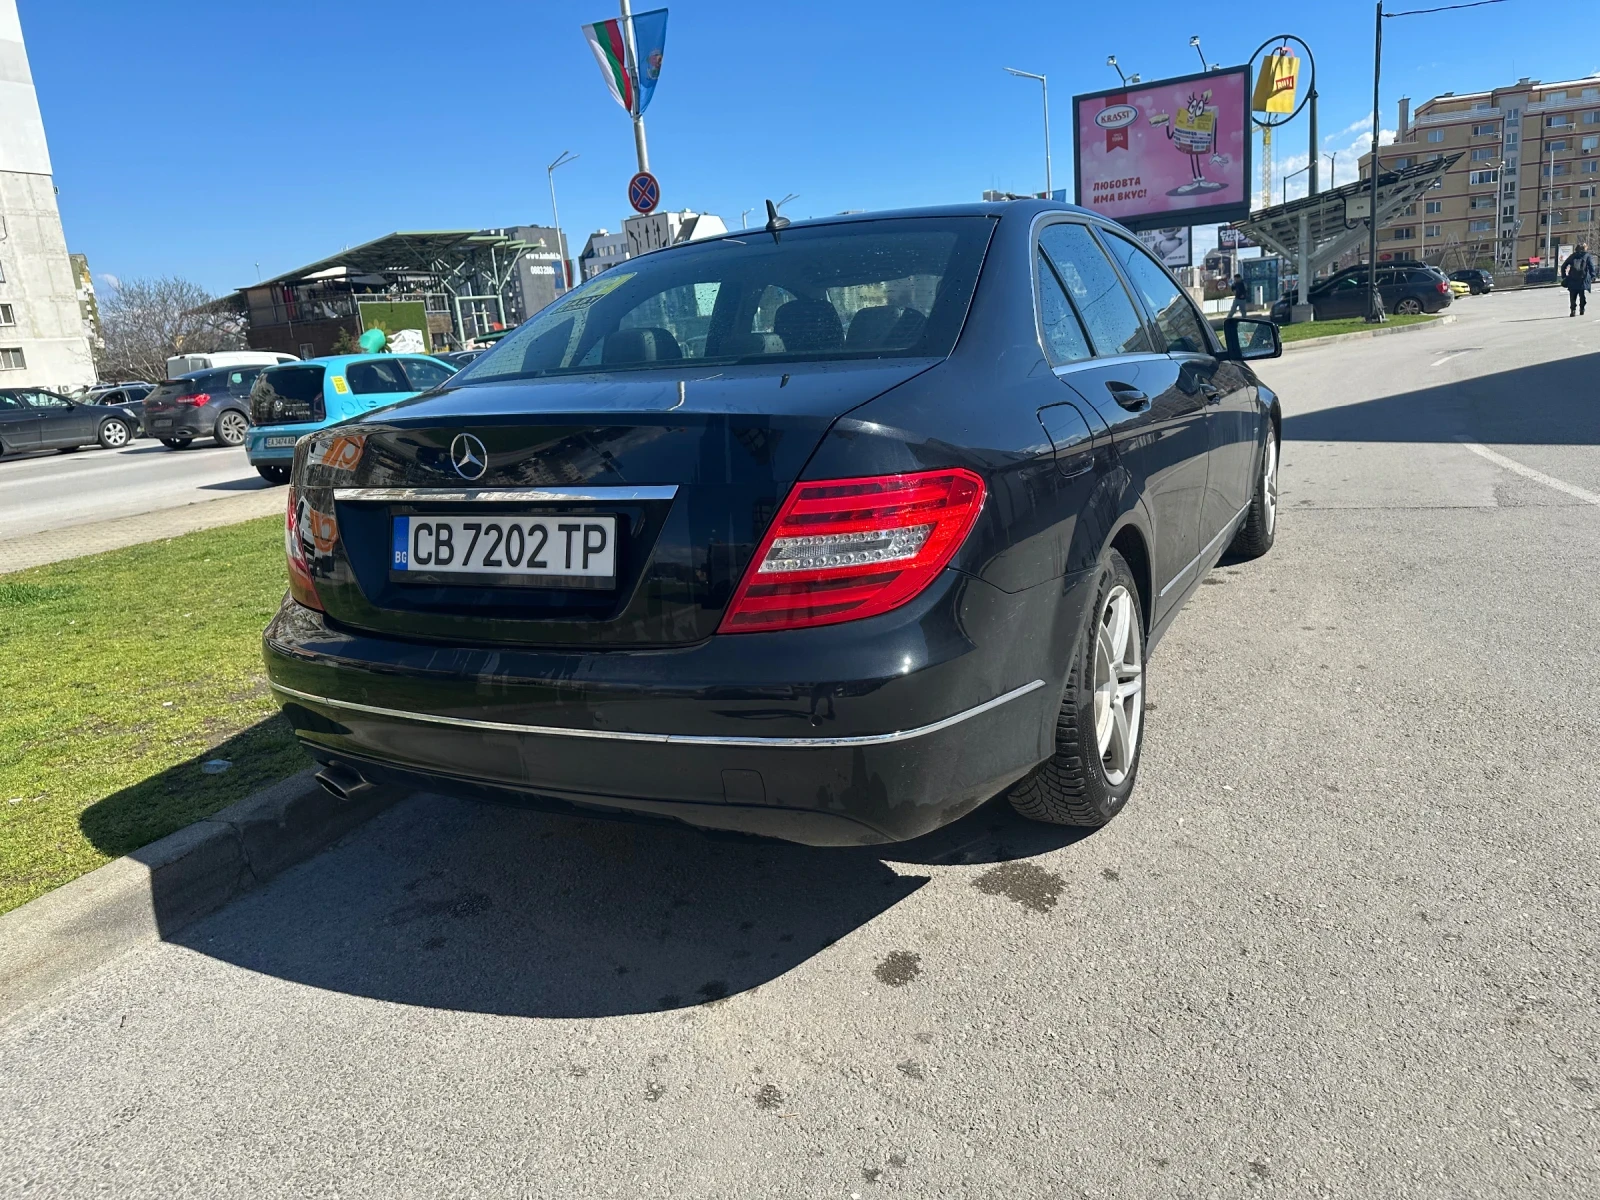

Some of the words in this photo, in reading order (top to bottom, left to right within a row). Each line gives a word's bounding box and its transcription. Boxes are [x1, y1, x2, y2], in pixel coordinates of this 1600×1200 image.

[1100, 110, 1130, 124] KRASSI
[1093, 177, 1141, 191] ЛЮБОВТА
[1093, 193, 1115, 204] ИМА
[1117, 189, 1148, 201] ВКУС!
[413, 522, 455, 566] CB
[461, 523, 549, 569] 7202
[557, 524, 607, 570] TP
[395, 551, 407, 563] BG
